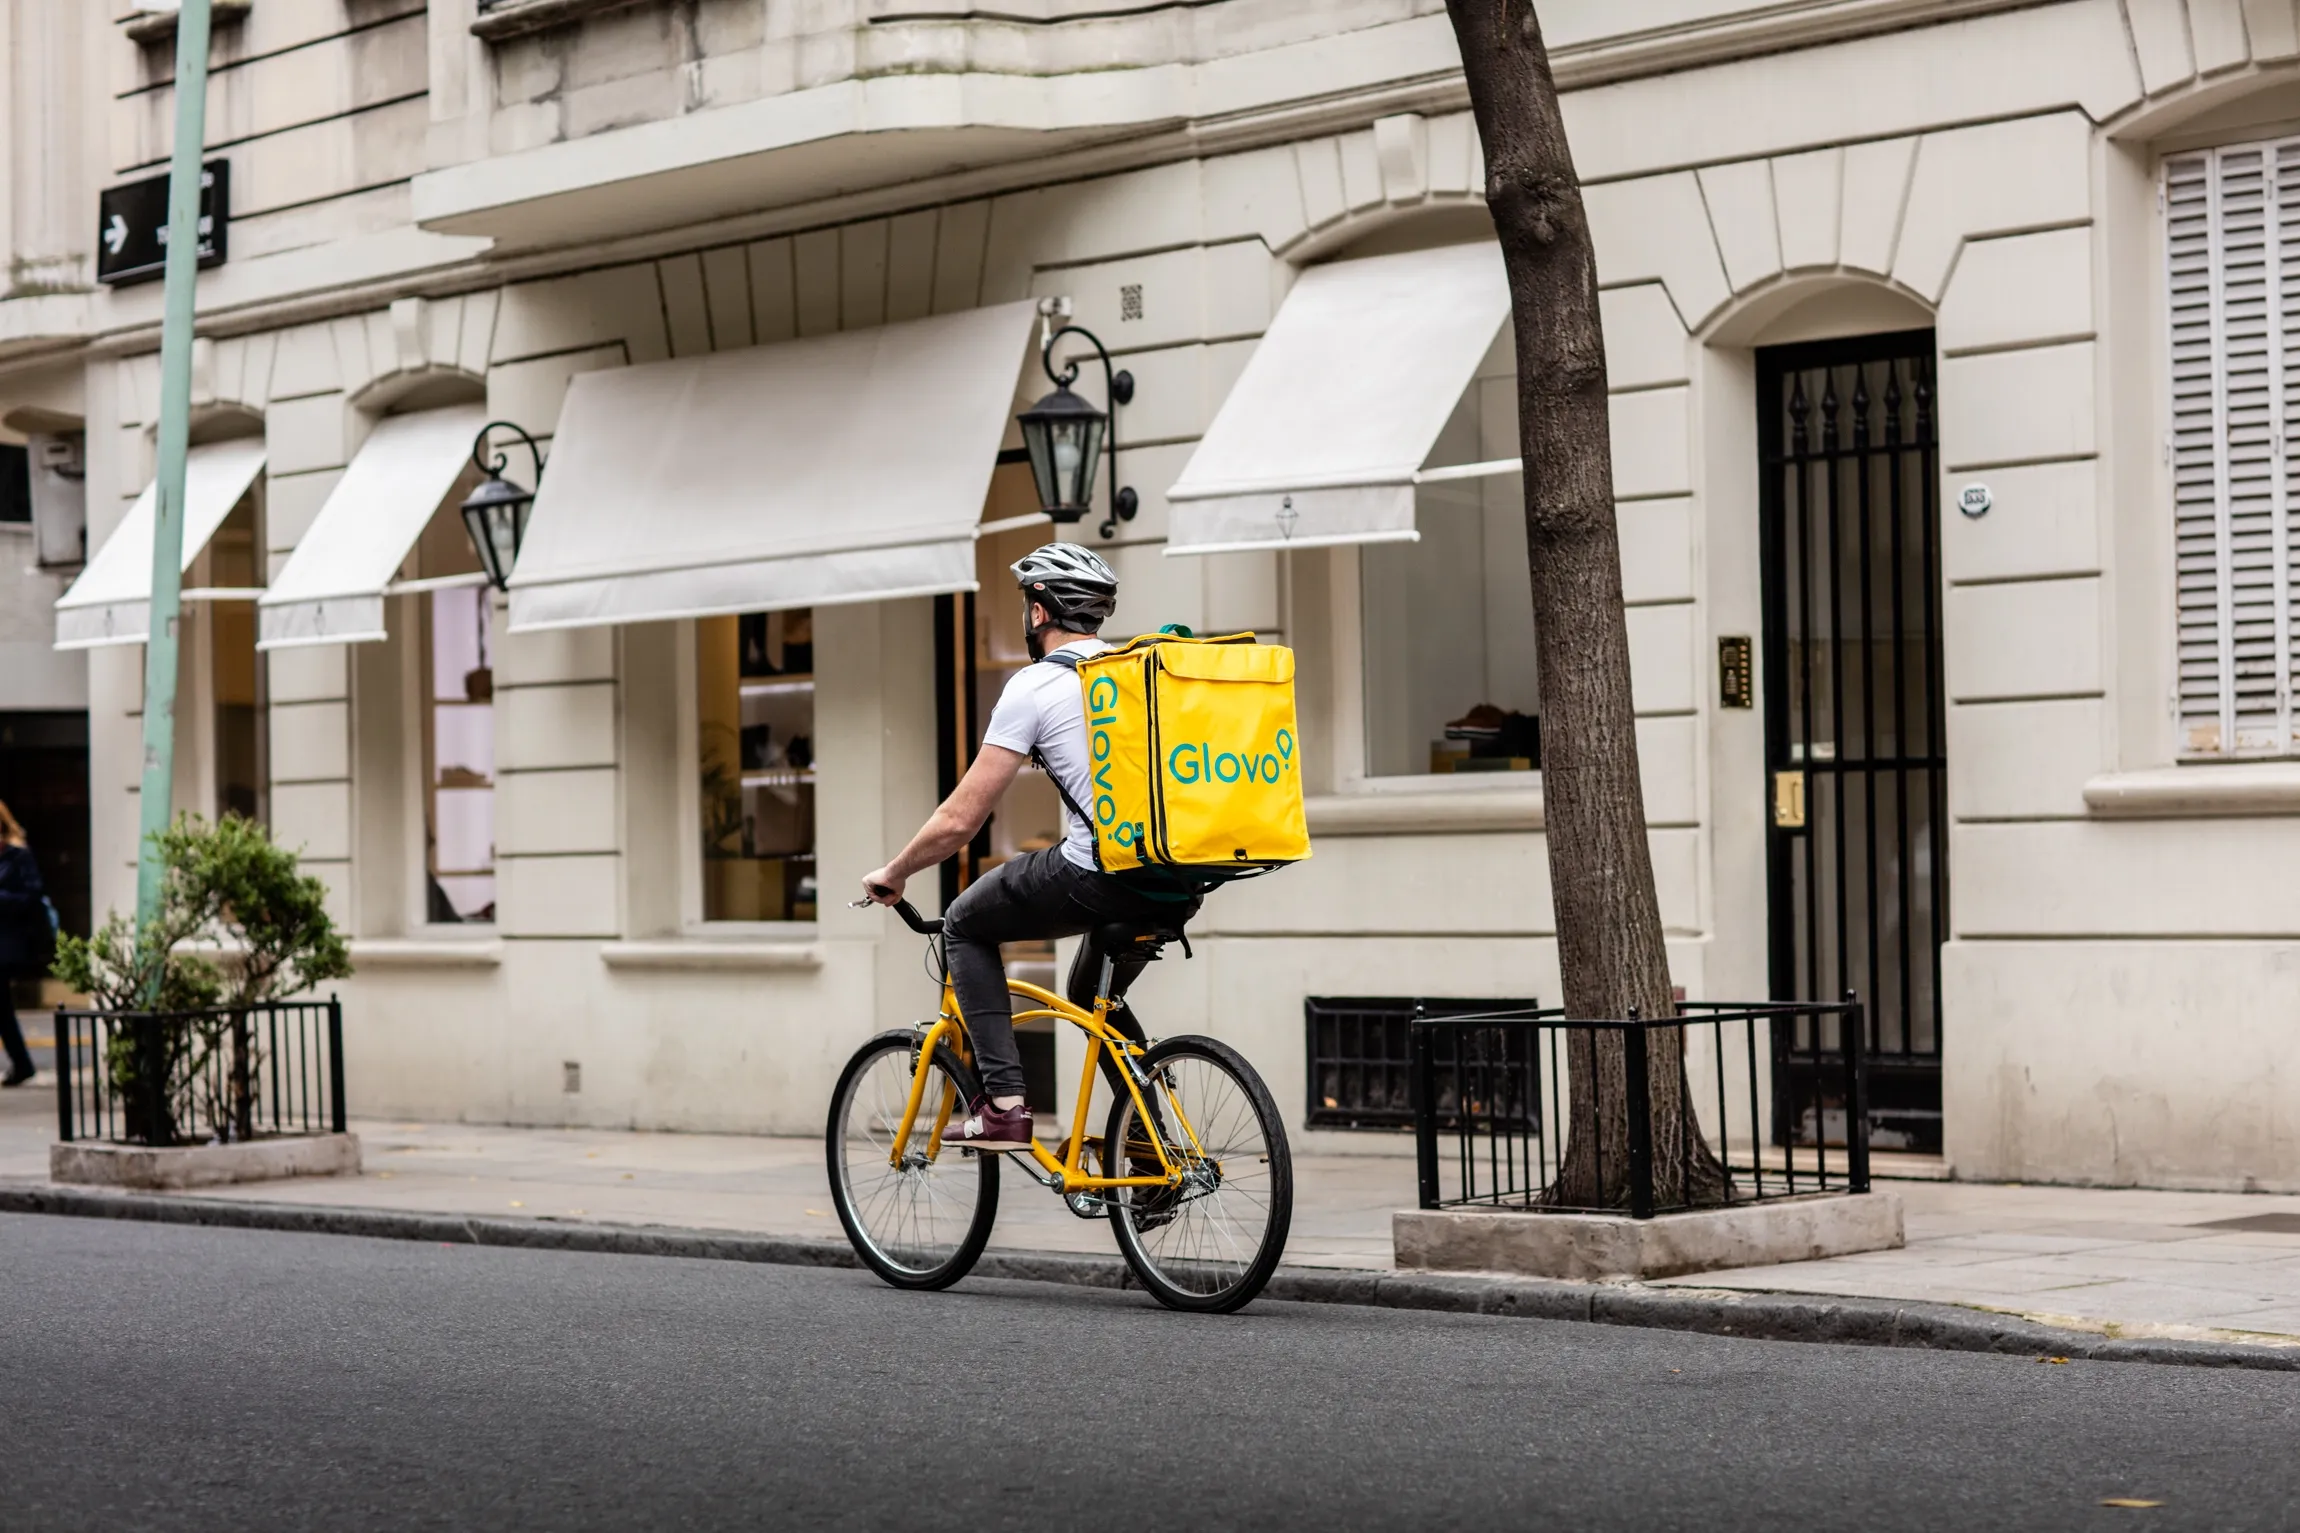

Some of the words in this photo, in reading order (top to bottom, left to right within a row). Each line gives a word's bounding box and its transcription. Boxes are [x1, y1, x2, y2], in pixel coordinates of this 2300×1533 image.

[1089, 676, 1118, 827] Glovo
[1169, 742, 1280, 785] Glovo
[964, 1115, 984, 1139] N
